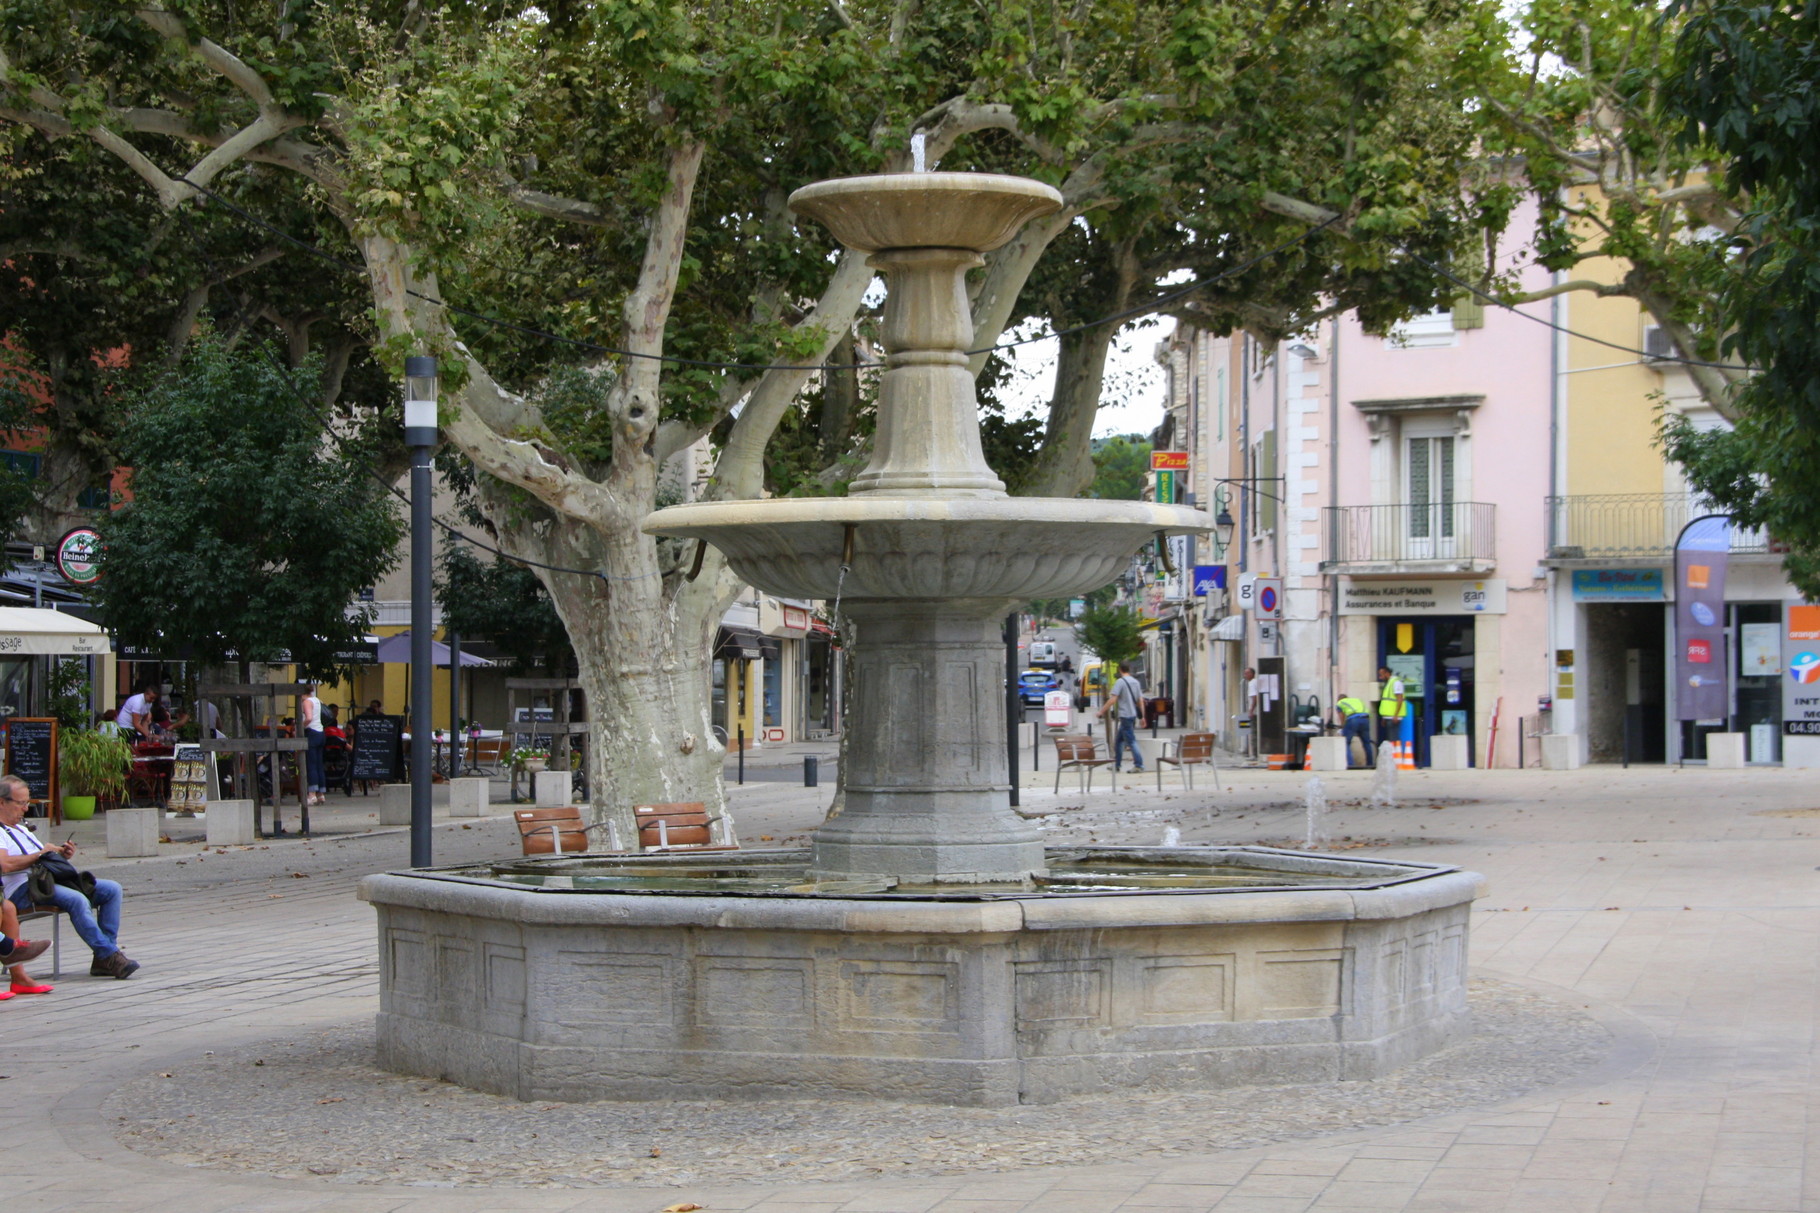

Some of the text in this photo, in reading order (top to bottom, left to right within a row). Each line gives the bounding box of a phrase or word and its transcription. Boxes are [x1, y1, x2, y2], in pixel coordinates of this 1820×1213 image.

[1194, 579, 1218, 592] AXA
[1345, 586, 1433, 597] Matthieu KAUFMANN
[1463, 591, 1485, 603] gan
[1345, 600, 1393, 609] Assurances
[1404, 599, 1436, 609] Banque
[1789, 630, 1819, 640] orange
[72, 644, 93, 652] Restaurant
